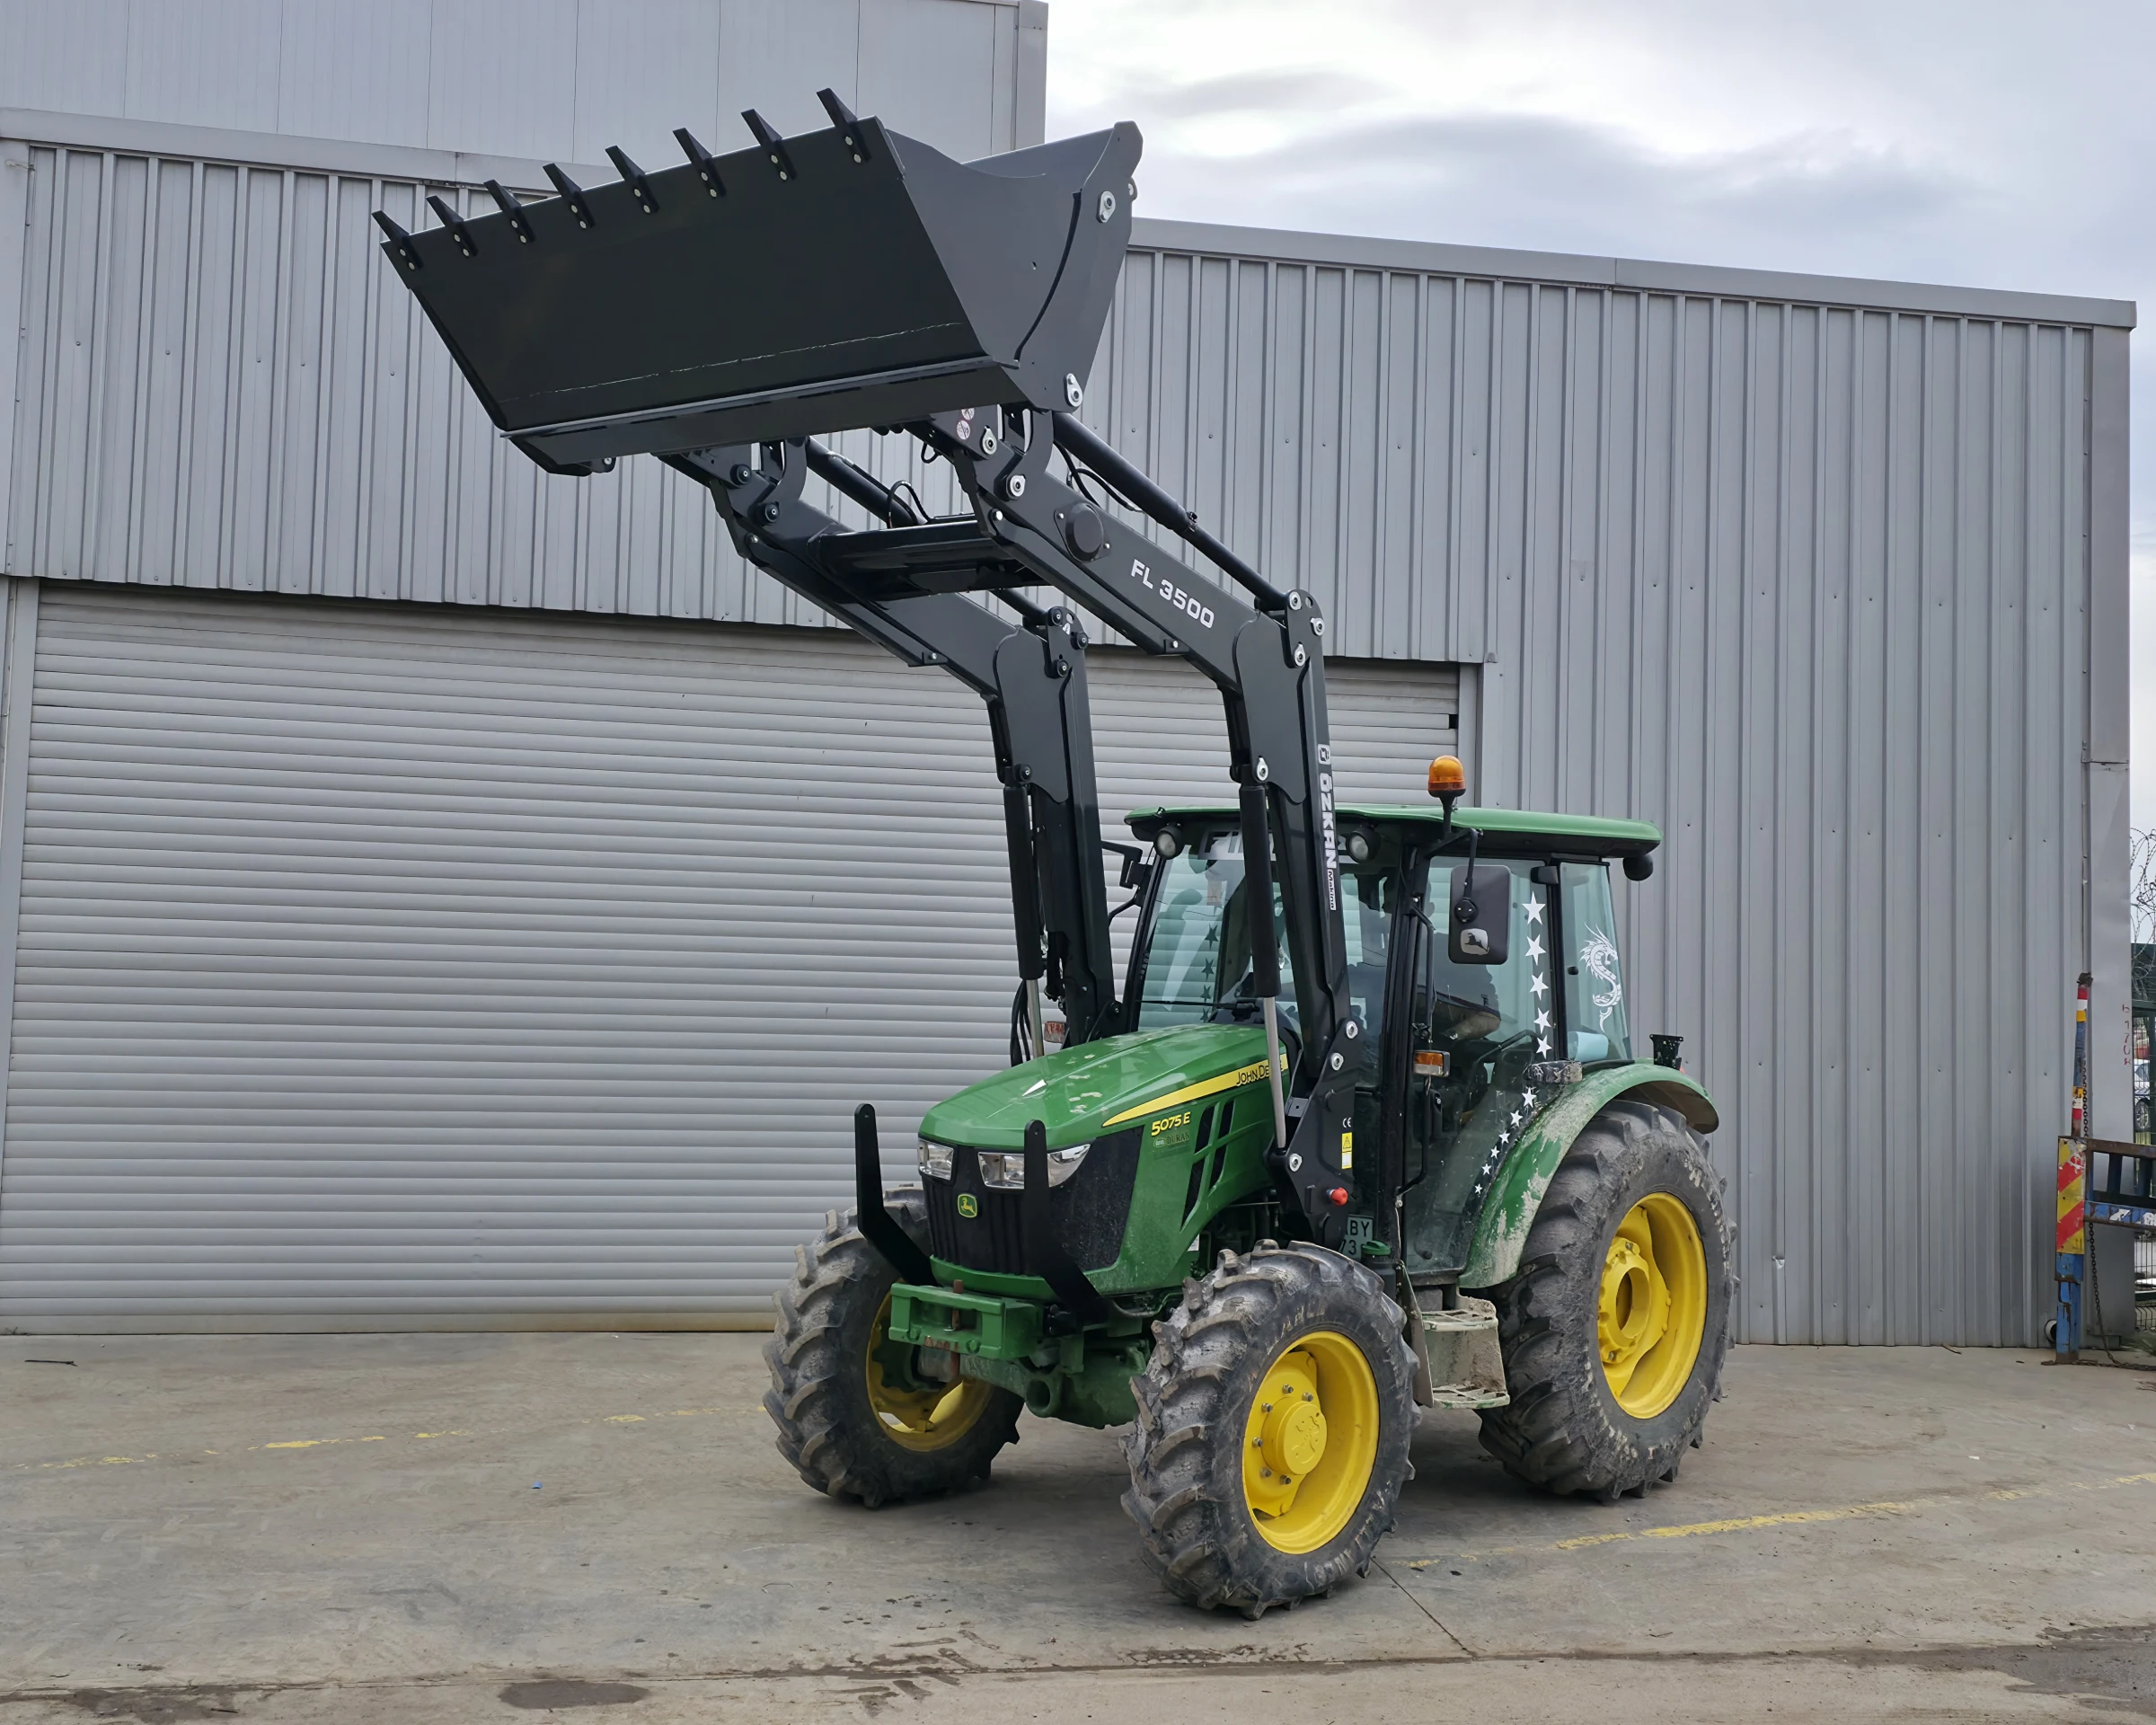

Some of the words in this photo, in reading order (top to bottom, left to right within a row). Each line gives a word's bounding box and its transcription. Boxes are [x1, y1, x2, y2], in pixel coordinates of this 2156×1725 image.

[1131, 559, 1153, 589] FL
[1159, 579, 1215, 629] 3500
[1236, 1069, 1259, 1085] JOHN
[1350, 1220, 1370, 1237] BY
